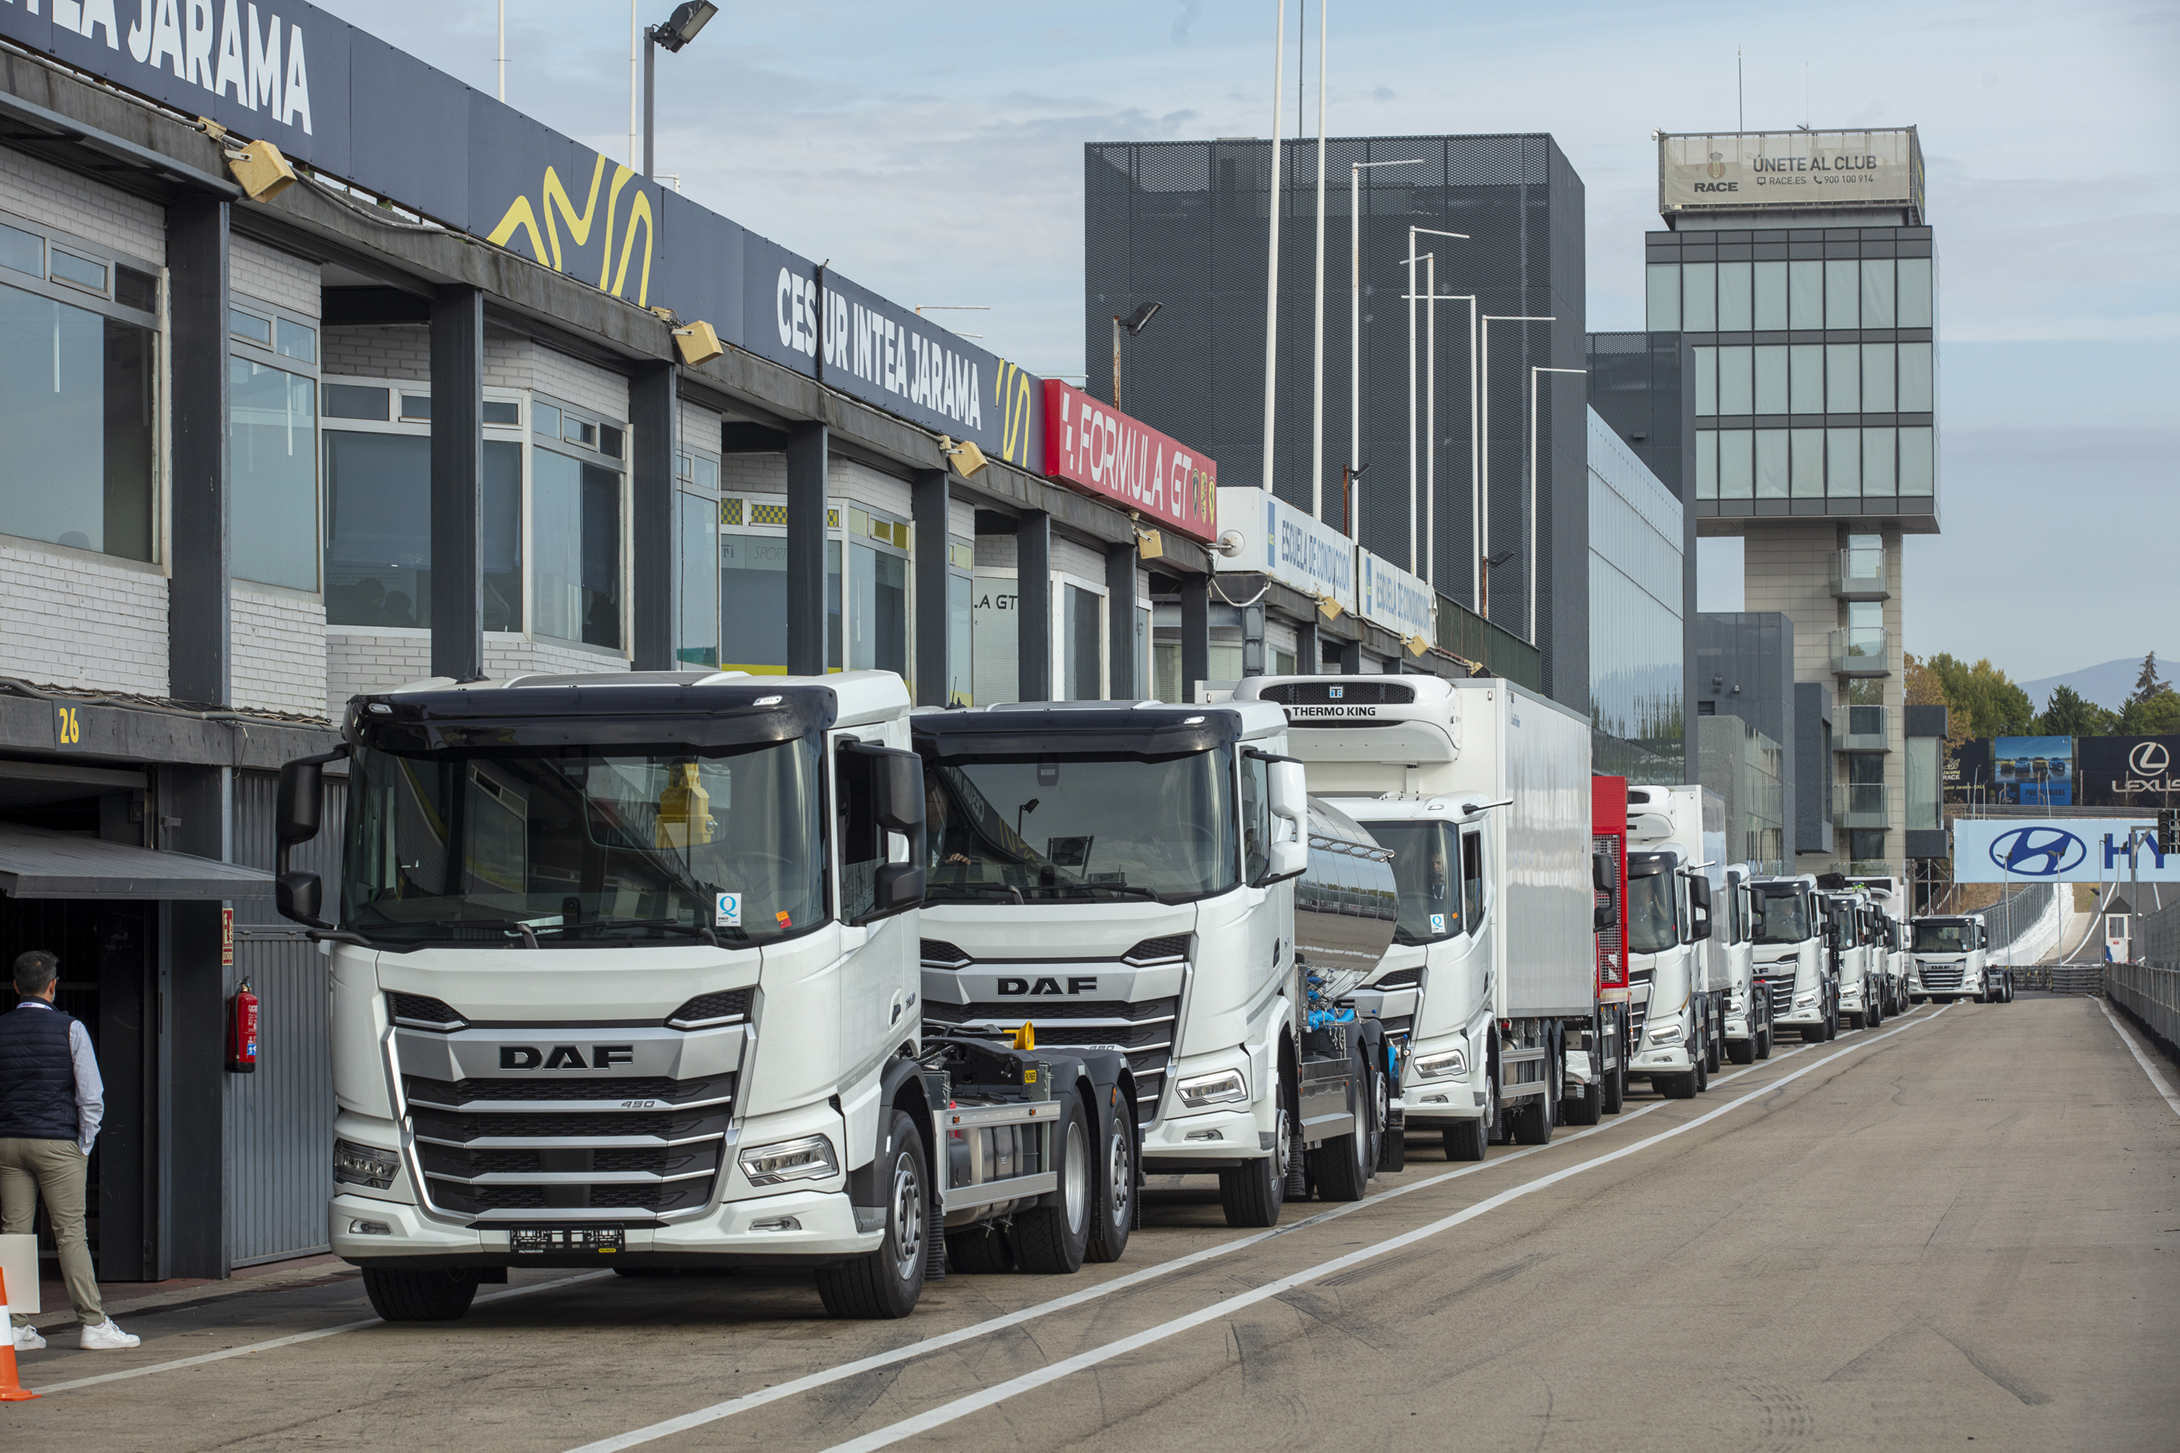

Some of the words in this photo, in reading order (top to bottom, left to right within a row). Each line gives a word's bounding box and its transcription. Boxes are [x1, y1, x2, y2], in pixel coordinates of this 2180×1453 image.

[127, 0, 313, 136] JARAMA
[1753, 154, 1807, 173] ÚNETE
[1810, 156, 1831, 171] AL
[1834, 155, 1877, 170] CLUB
[1694, 182, 1738, 192] RACE
[1769, 176, 1806, 185] RACE.ES
[1824, 175, 1839, 184] 900
[1842, 175, 1856, 183] 100
[1858, 174, 1874, 183] 914
[777, 266, 849, 372] CESUR
[853, 302, 908, 398] INTEA
[910, 331, 982, 431] JARAMA
[1078, 403, 1163, 511] FORMULA
[1171, 451, 1192, 520] GT
[1282, 520, 1307, 573] ESCUELA
[1309, 534, 1317, 577] DE
[1293, 706, 1344, 717] THERMO
[1347, 706, 1376, 717] KING
[59, 707, 80, 744] 26
[719, 896, 738, 917] Q
[997, 976, 1097, 997] DAF
[499, 1044, 633, 1071] DAF
[621, 1100, 655, 1108] 450
